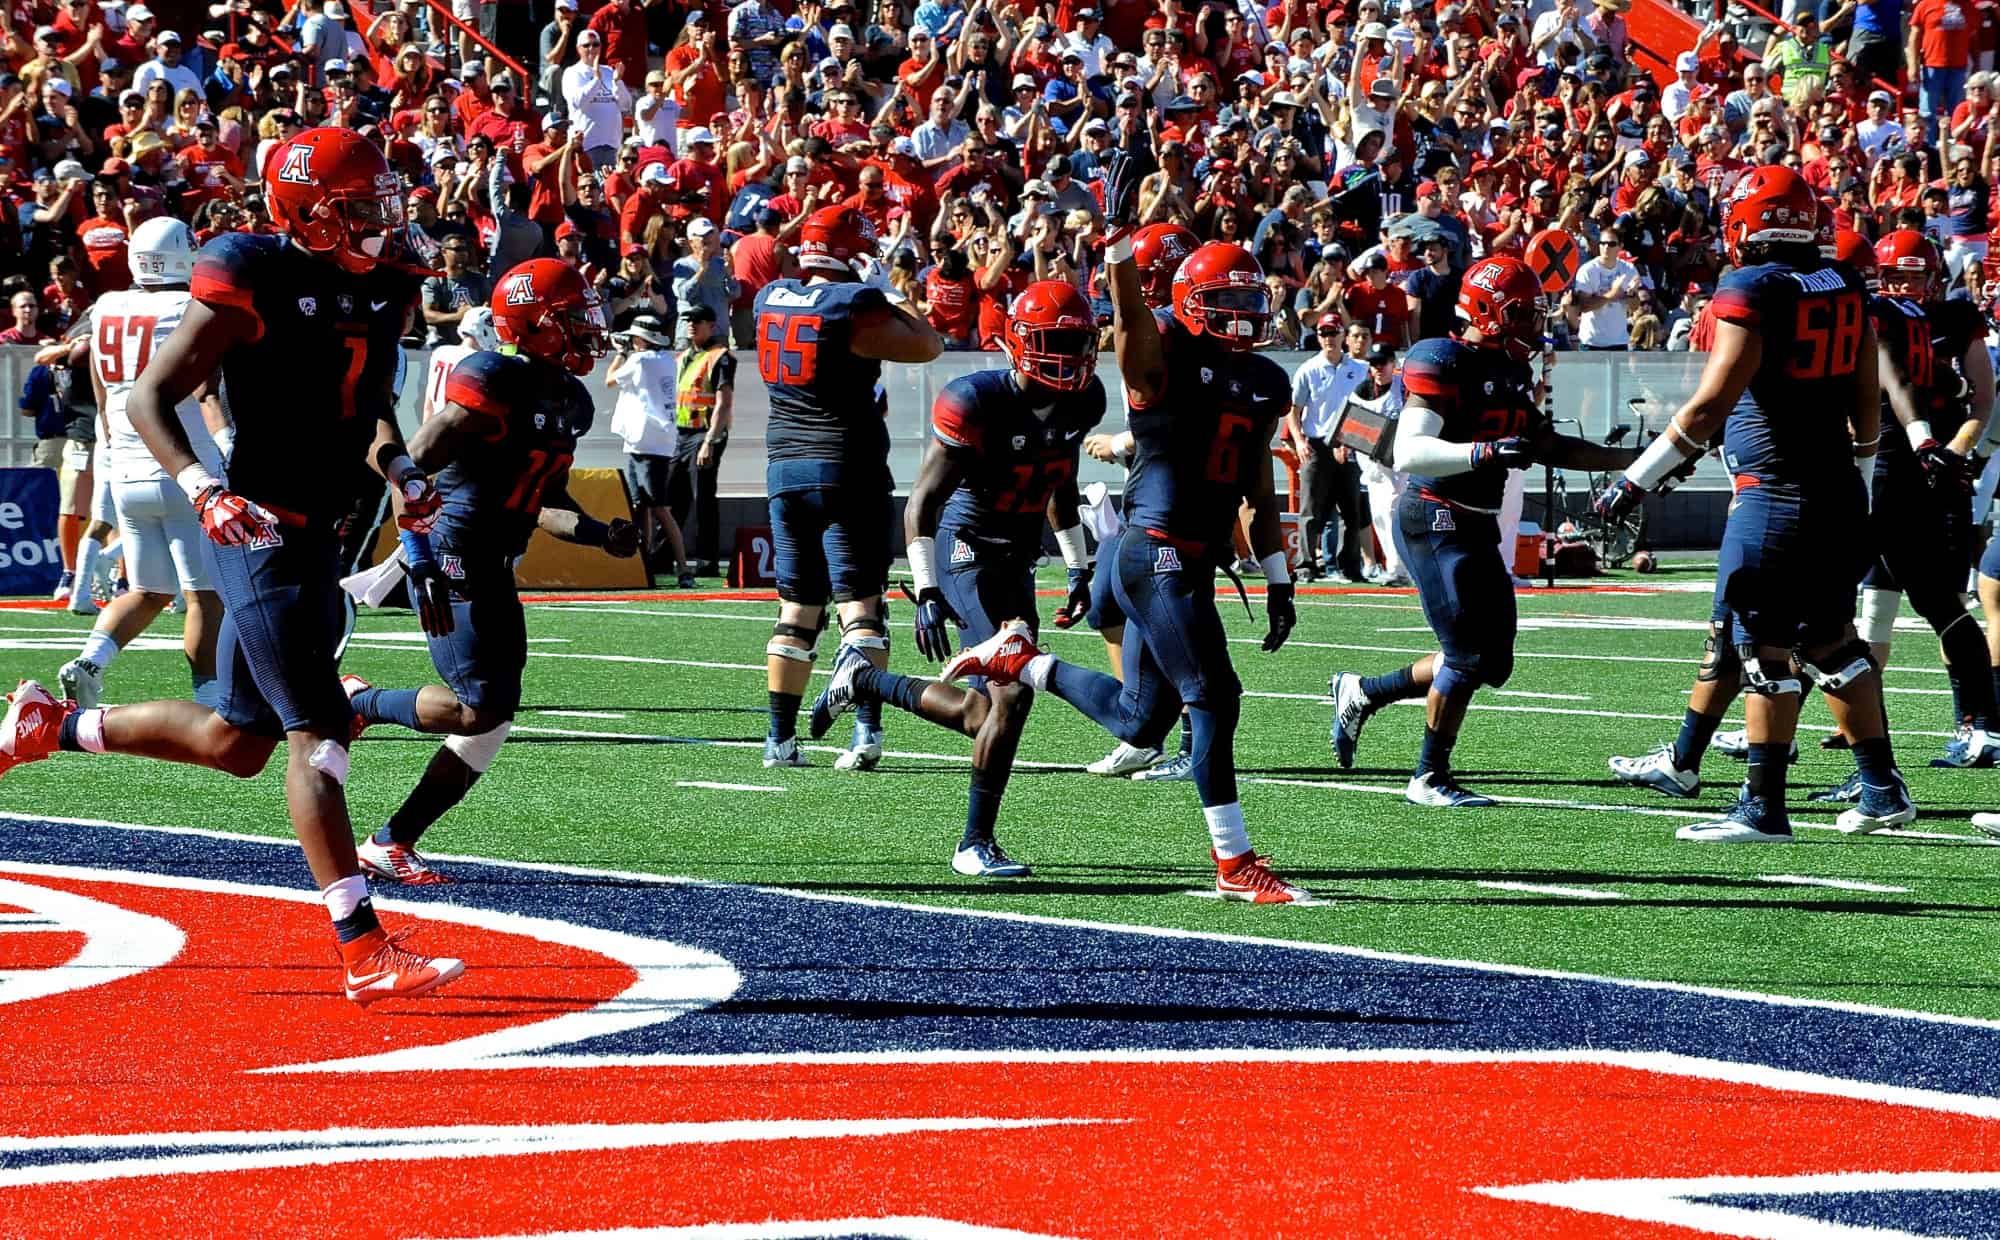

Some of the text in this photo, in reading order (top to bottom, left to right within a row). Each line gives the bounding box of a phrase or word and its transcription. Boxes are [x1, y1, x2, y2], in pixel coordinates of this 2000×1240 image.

[279, 144, 314, 184] A
[506, 273, 537, 305] A
[1469, 262, 1504, 293] A
[98, 315, 159, 383] 97
[756, 311, 824, 386] 65
[1790, 293, 1862, 379] 58
[342, 336, 368, 419] 7
[1206, 412, 1254, 482] 6
[950, 539, 975, 564] A
[1153, 546, 1183, 573] A
[15, 706, 44, 740] NIKE
